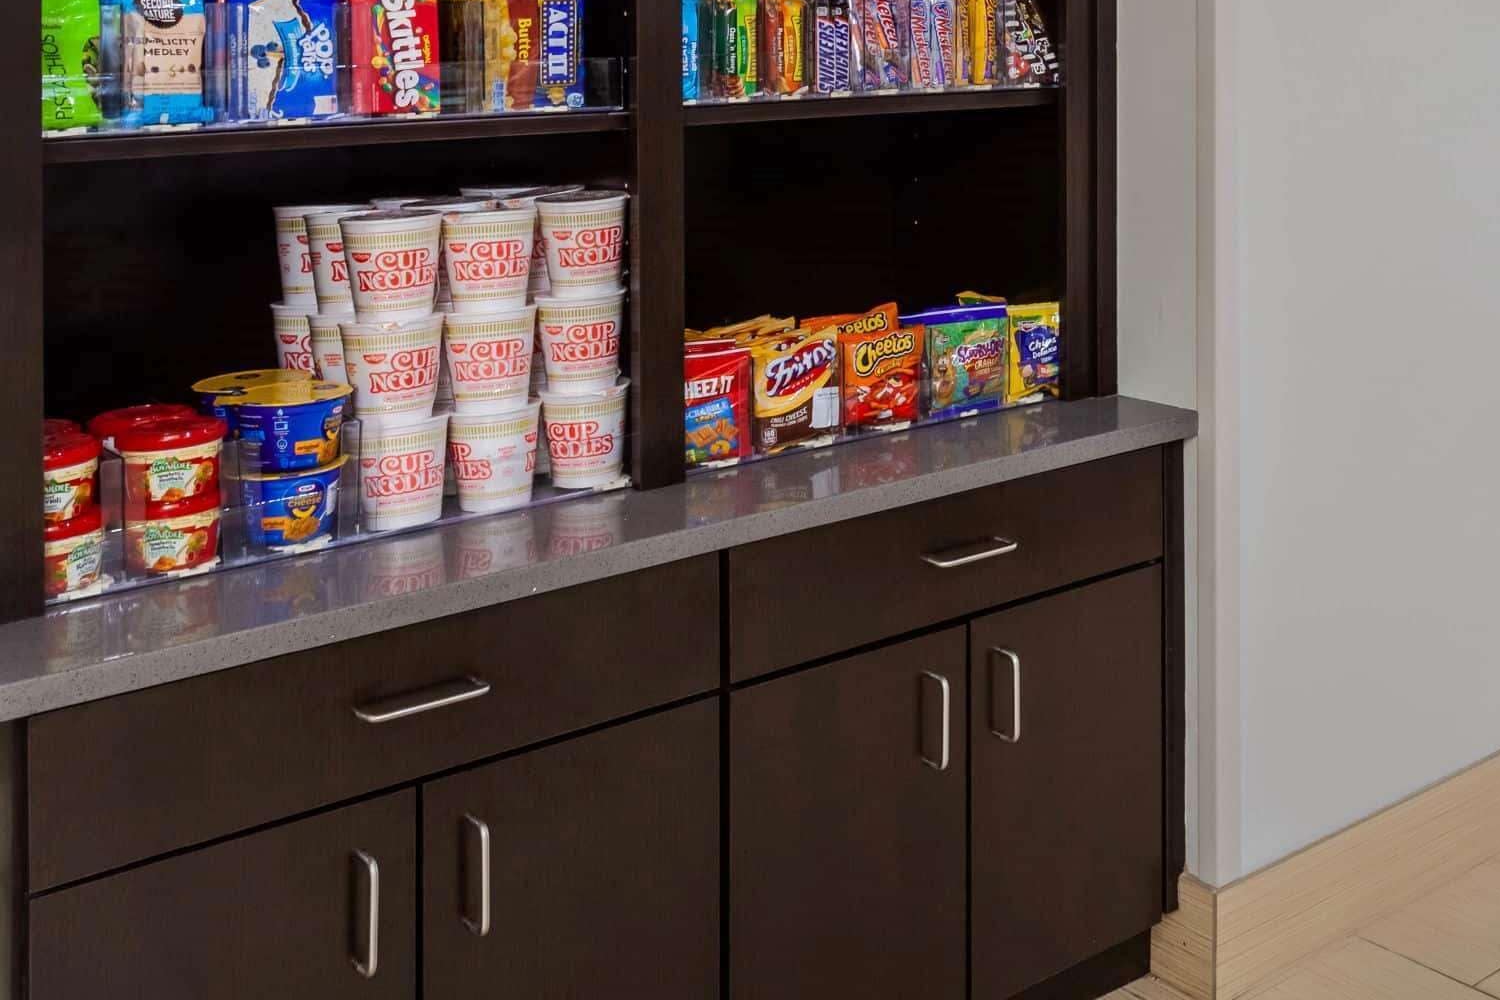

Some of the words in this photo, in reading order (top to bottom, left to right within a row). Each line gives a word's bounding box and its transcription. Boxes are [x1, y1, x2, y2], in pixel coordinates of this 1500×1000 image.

[548, 7, 569, 43] ACT
[143, 48, 190, 57] MEDLEY
[421, 34, 432, 64] ORIGINAL
[518, 17, 532, 67] Butter
[819, 21, 835, 93] SNICKERS
[835, 20, 849, 91] SNICKERS
[574, 225, 622, 249] CUP
[375, 248, 430, 272] CUP
[470, 239, 525, 262] CUP
[566, 320, 616, 344] CUP
[1027, 335, 1057, 353] Chips
[470, 339, 525, 362] CUP
[855, 331, 916, 377] Cheetos
[765, 338, 837, 398] Fritos
[548, 420, 599, 443] CUP
[379, 451, 435, 477] CUP
[365, 464, 444, 498] NOODLES
